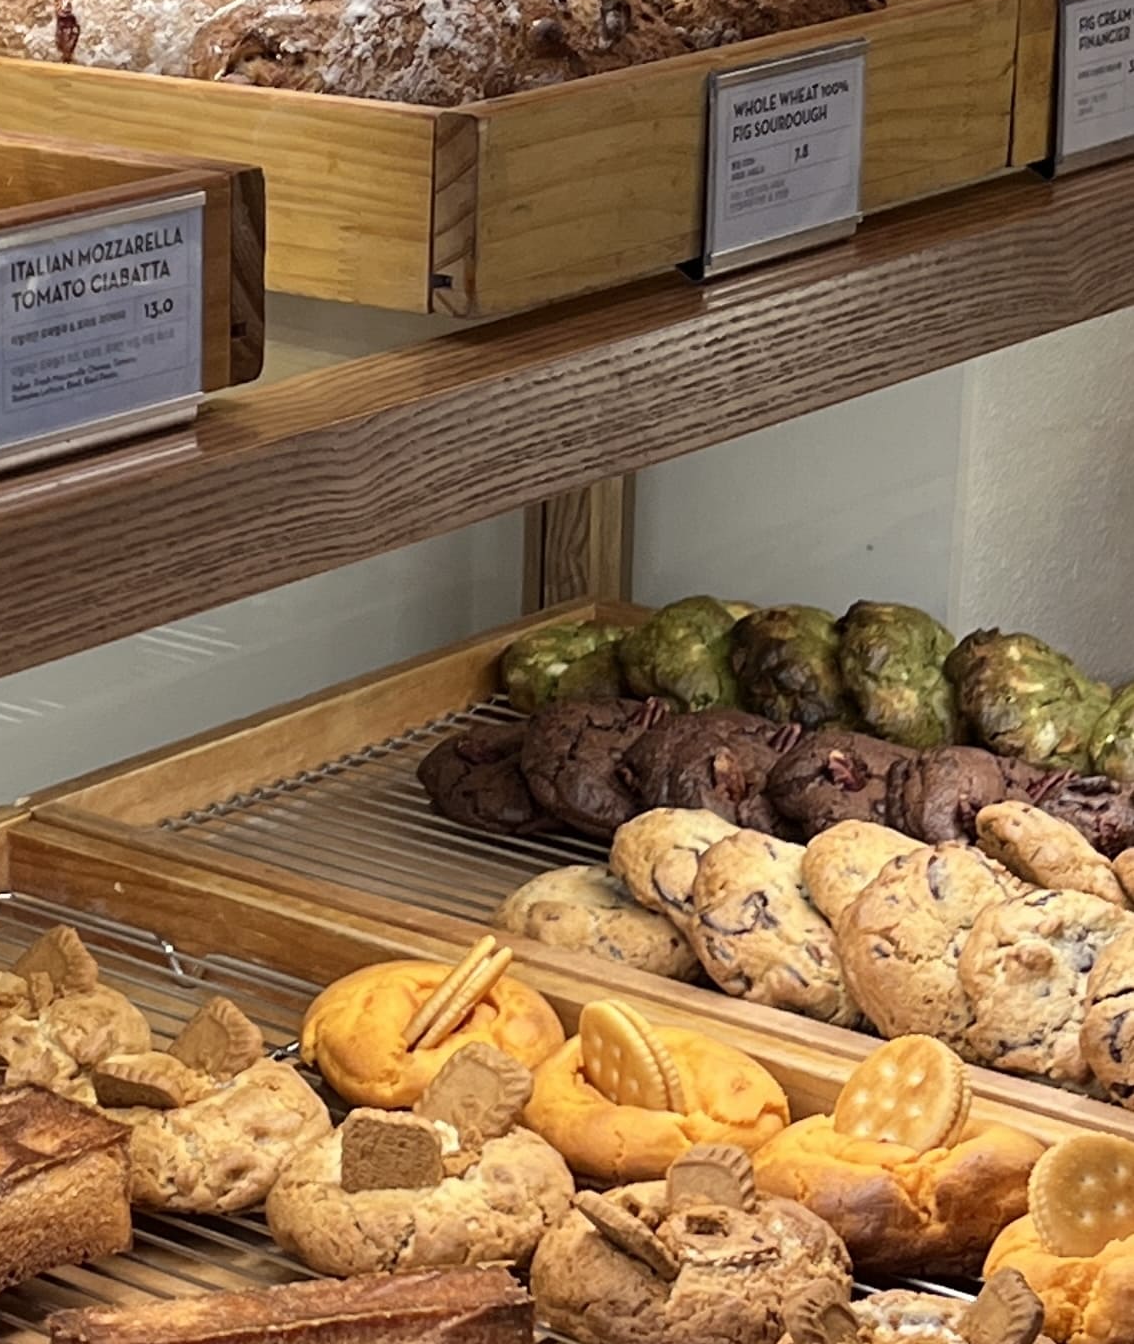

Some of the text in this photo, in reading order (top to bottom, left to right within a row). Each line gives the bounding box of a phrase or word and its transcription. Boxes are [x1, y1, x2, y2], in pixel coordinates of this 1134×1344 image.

[733, 79, 849, 118] WHOLE WHEAT 100%
[732, 104, 828, 143] FIG SOURDOUGH
[10, 226, 183, 283] ITALIAN MOZZARELLA
[12, 259, 170, 313] TOMATO CIABATTA
[144, 298, 173, 320] 13.0
